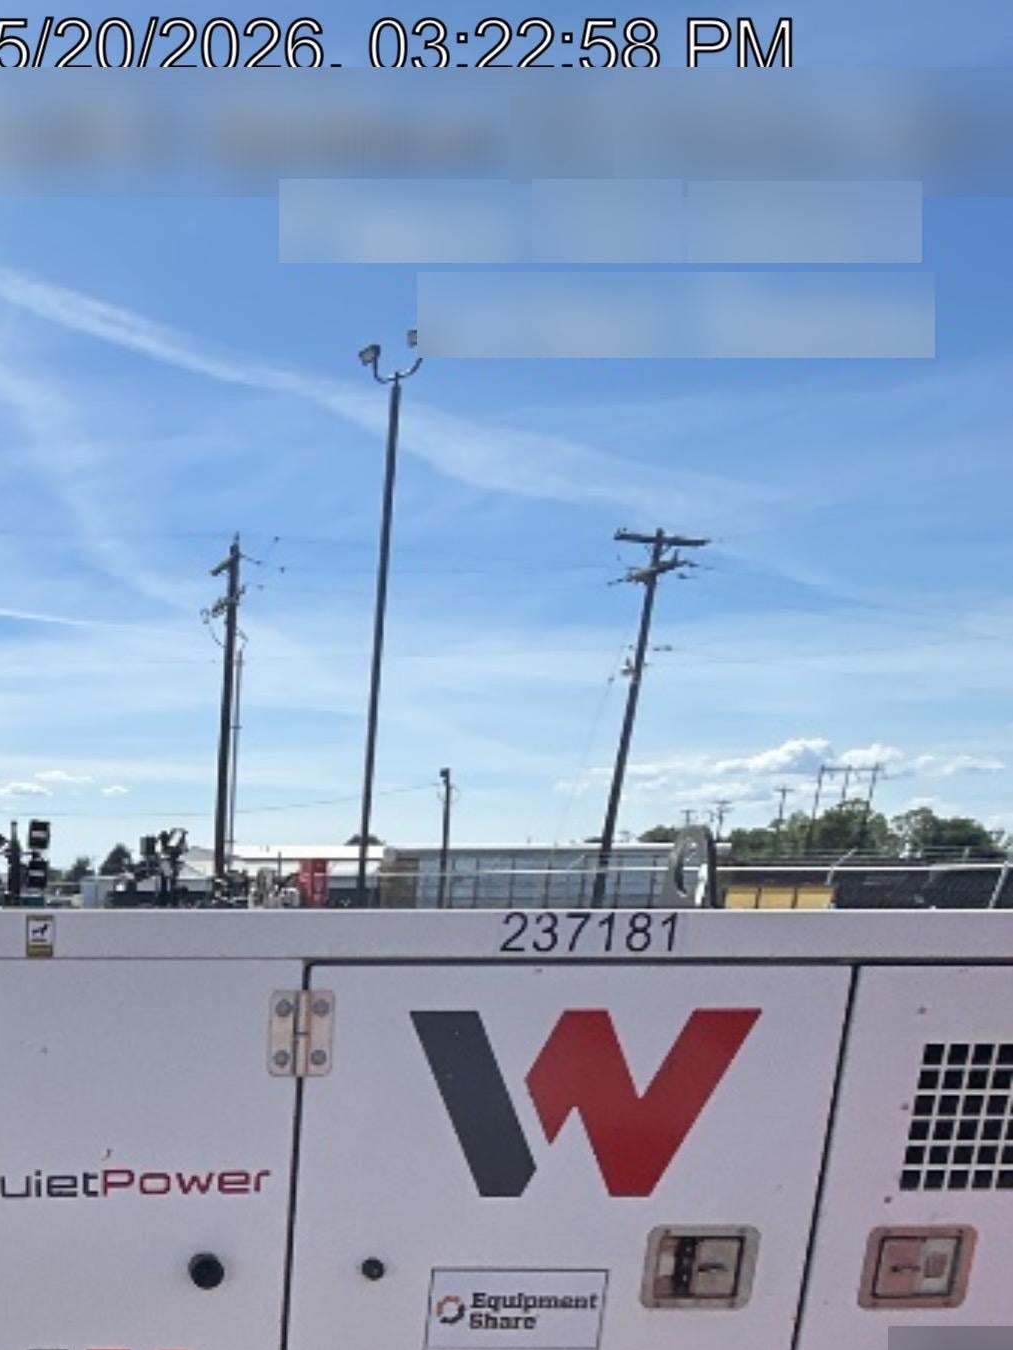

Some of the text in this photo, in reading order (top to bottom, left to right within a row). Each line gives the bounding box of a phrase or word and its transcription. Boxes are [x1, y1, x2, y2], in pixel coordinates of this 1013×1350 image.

[499, 911, 680, 953] 237181
[469, 1291, 599, 1313] Equipment
[468, 1311, 538, 1330] Share
